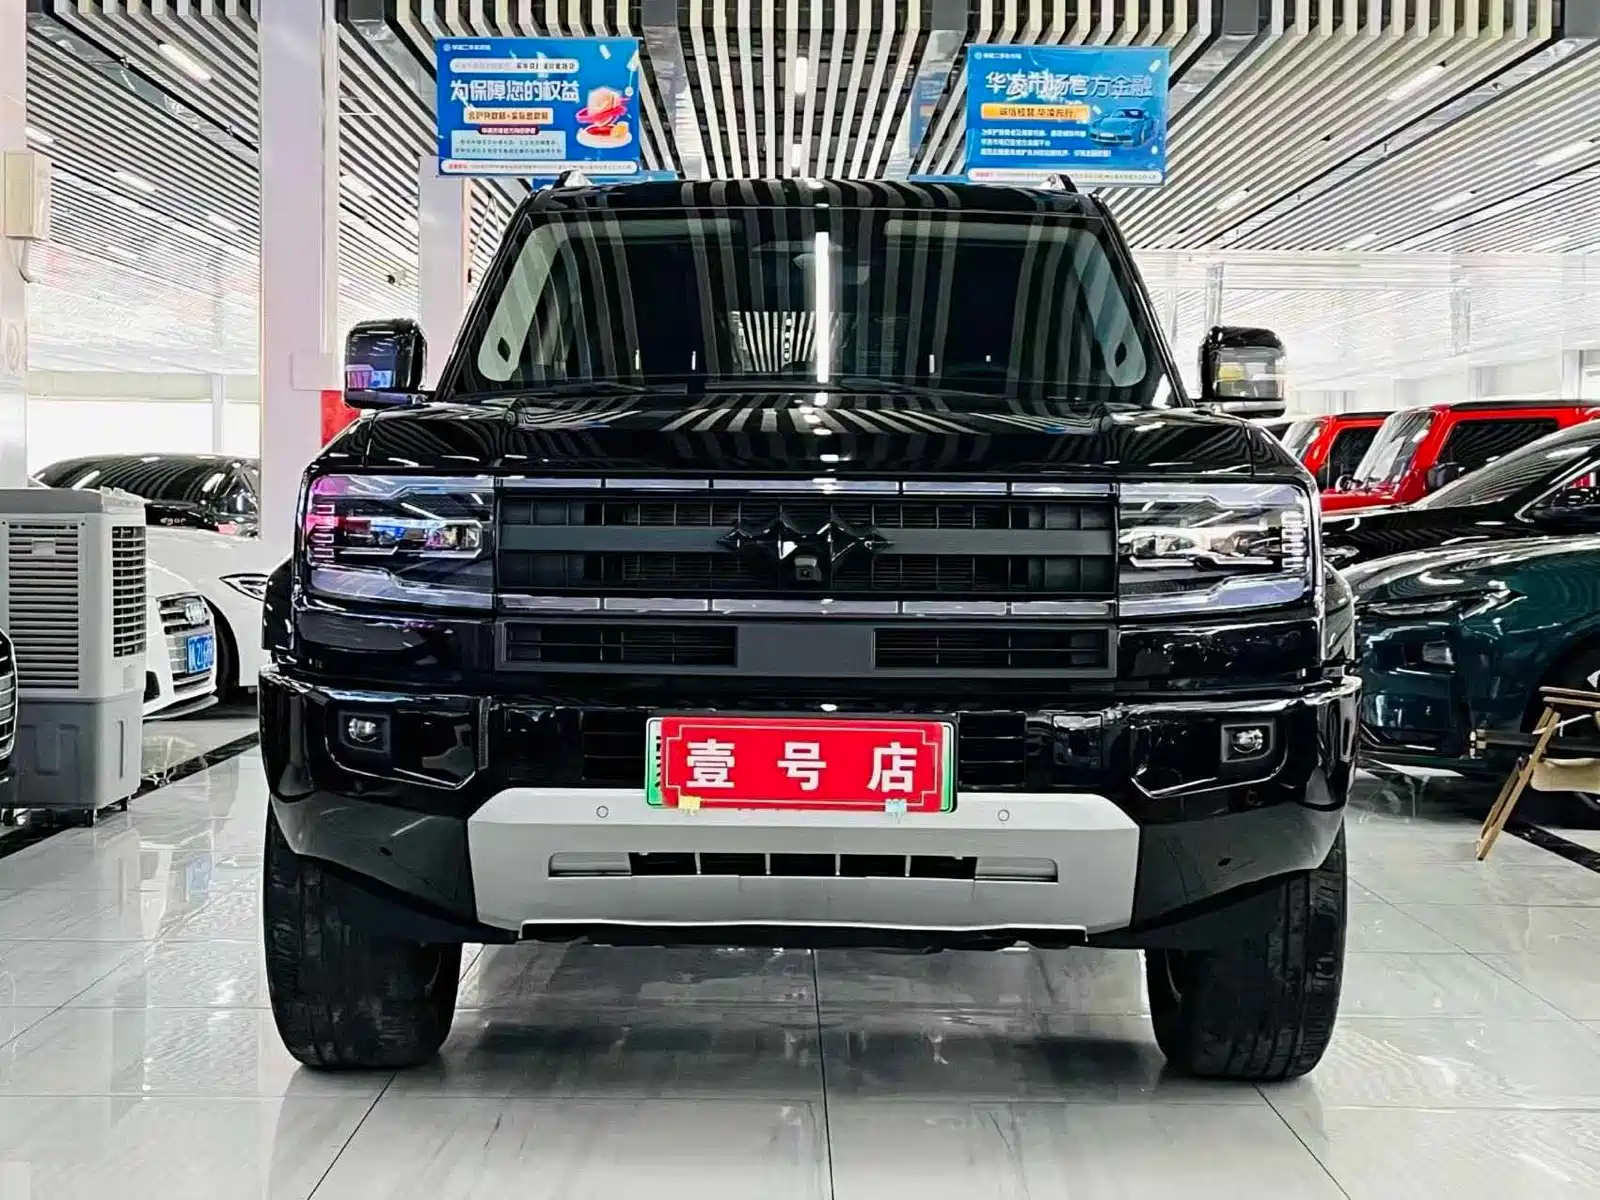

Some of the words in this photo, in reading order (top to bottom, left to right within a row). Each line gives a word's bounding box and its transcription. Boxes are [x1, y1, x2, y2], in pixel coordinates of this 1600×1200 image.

[450, 79, 580, 103] 为保障您的权益
[685, 738, 918, 793] 壹号店
